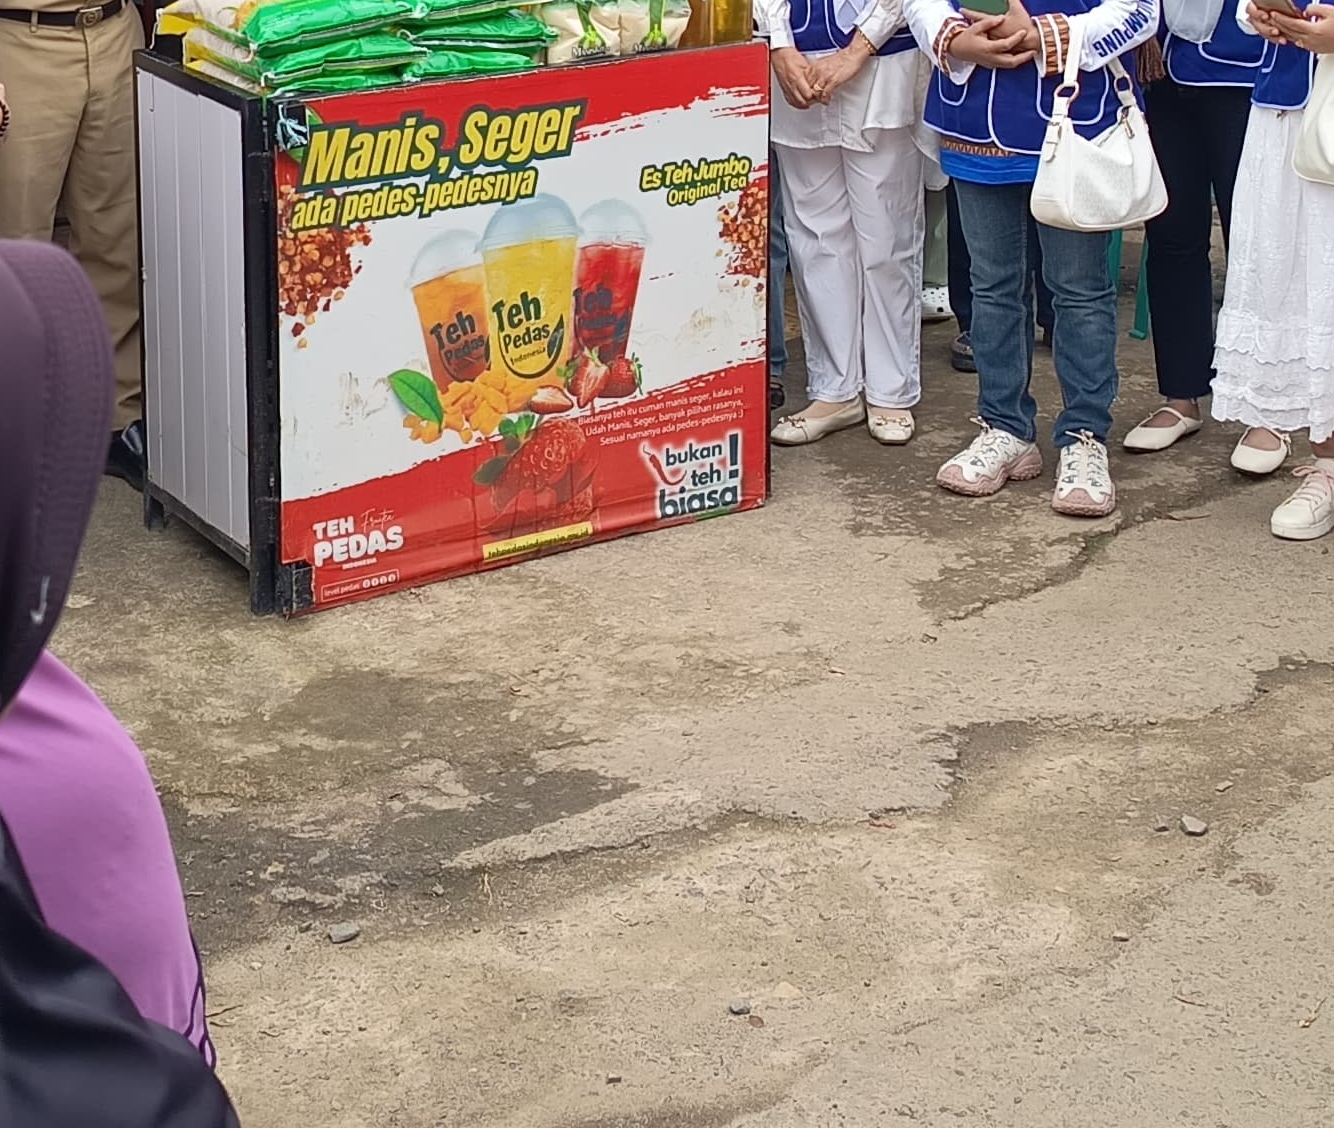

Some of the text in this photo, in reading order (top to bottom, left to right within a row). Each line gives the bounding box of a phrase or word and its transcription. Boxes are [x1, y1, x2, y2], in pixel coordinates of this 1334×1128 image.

[302, 104, 581, 185] Manis, Seger
[641, 155, 750, 190] Es Teh Jumbo
[291, 169, 535, 229] ada pedes-pedesnya
[668, 176, 747, 205] Original Tea
[492, 291, 542, 333] Teh
[430, 311, 476, 350] Teh
[503, 323, 550, 354] Pedas
[585, 424, 606, 437] Udah
[658, 408, 685, 421] banyak
[627, 427, 661, 440] namanya
[665, 442, 722, 467] bukan
[690, 462, 722, 487] teh
[658, 485, 739, 520] biasa
[312, 515, 355, 540] TEH
[313, 525, 404, 568] PEDAS
